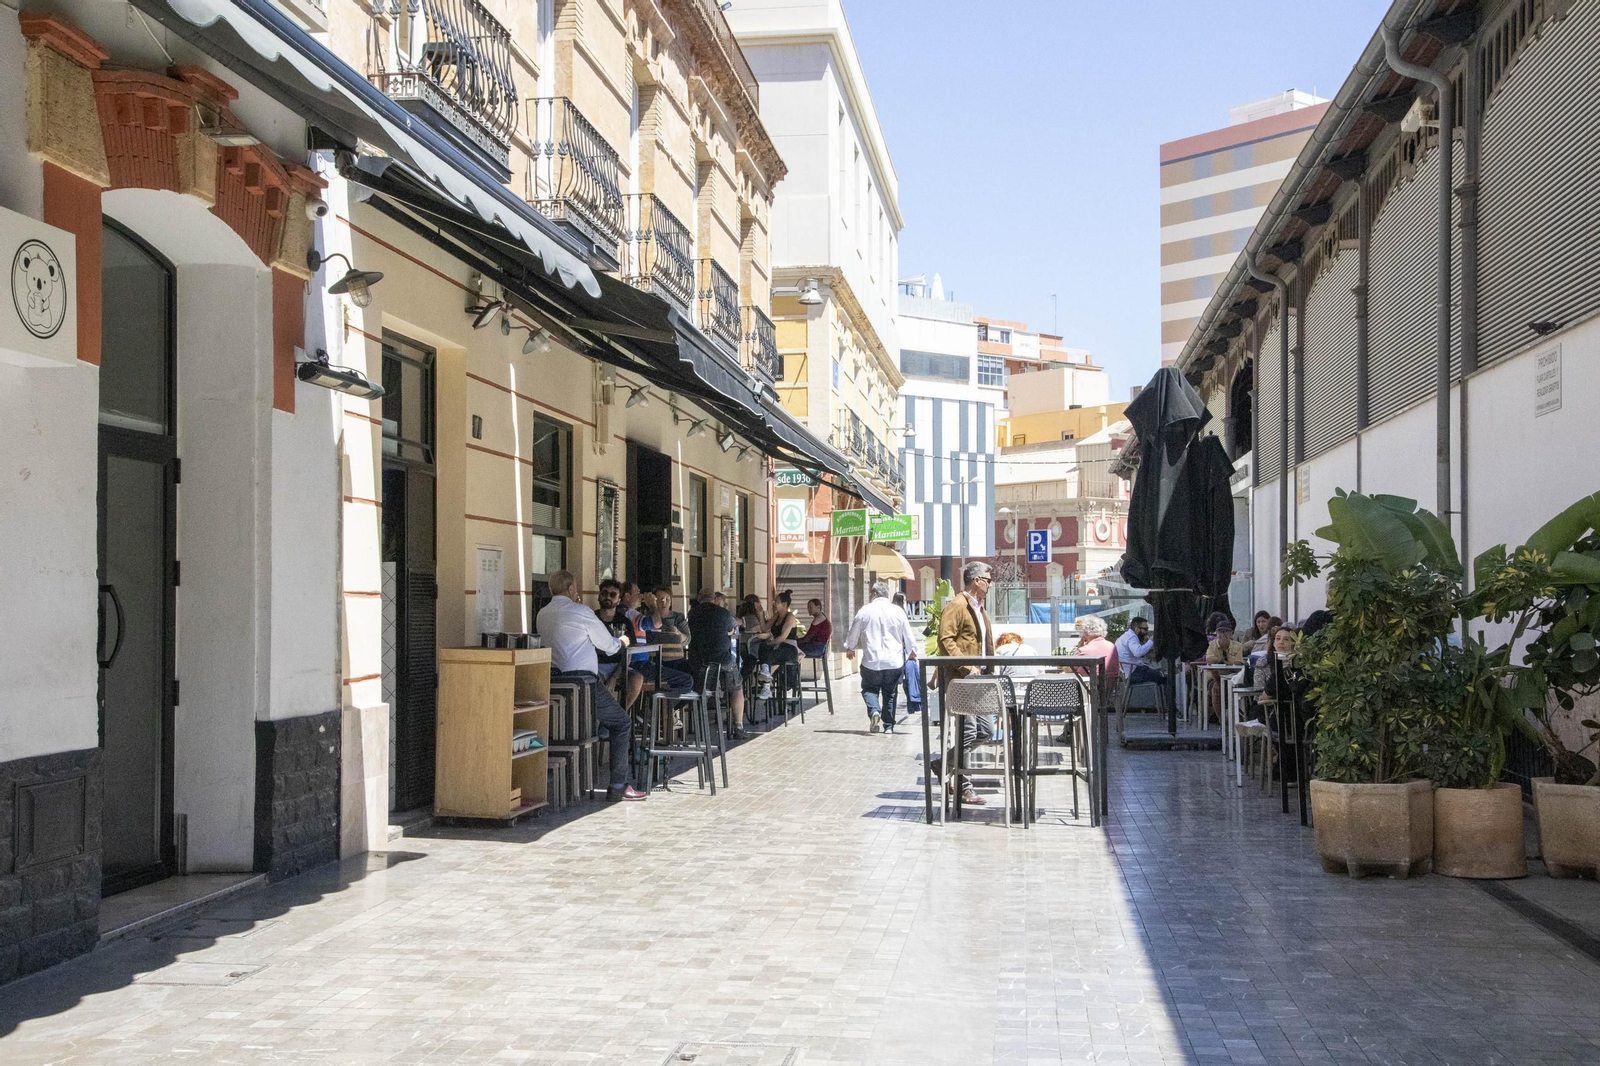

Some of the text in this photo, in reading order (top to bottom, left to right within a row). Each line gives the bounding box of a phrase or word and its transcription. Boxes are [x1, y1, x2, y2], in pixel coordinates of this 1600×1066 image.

[777, 473, 791, 484] sde
[834, 524, 865, 536] Martínez
[1030, 532, 1042, 551] P
